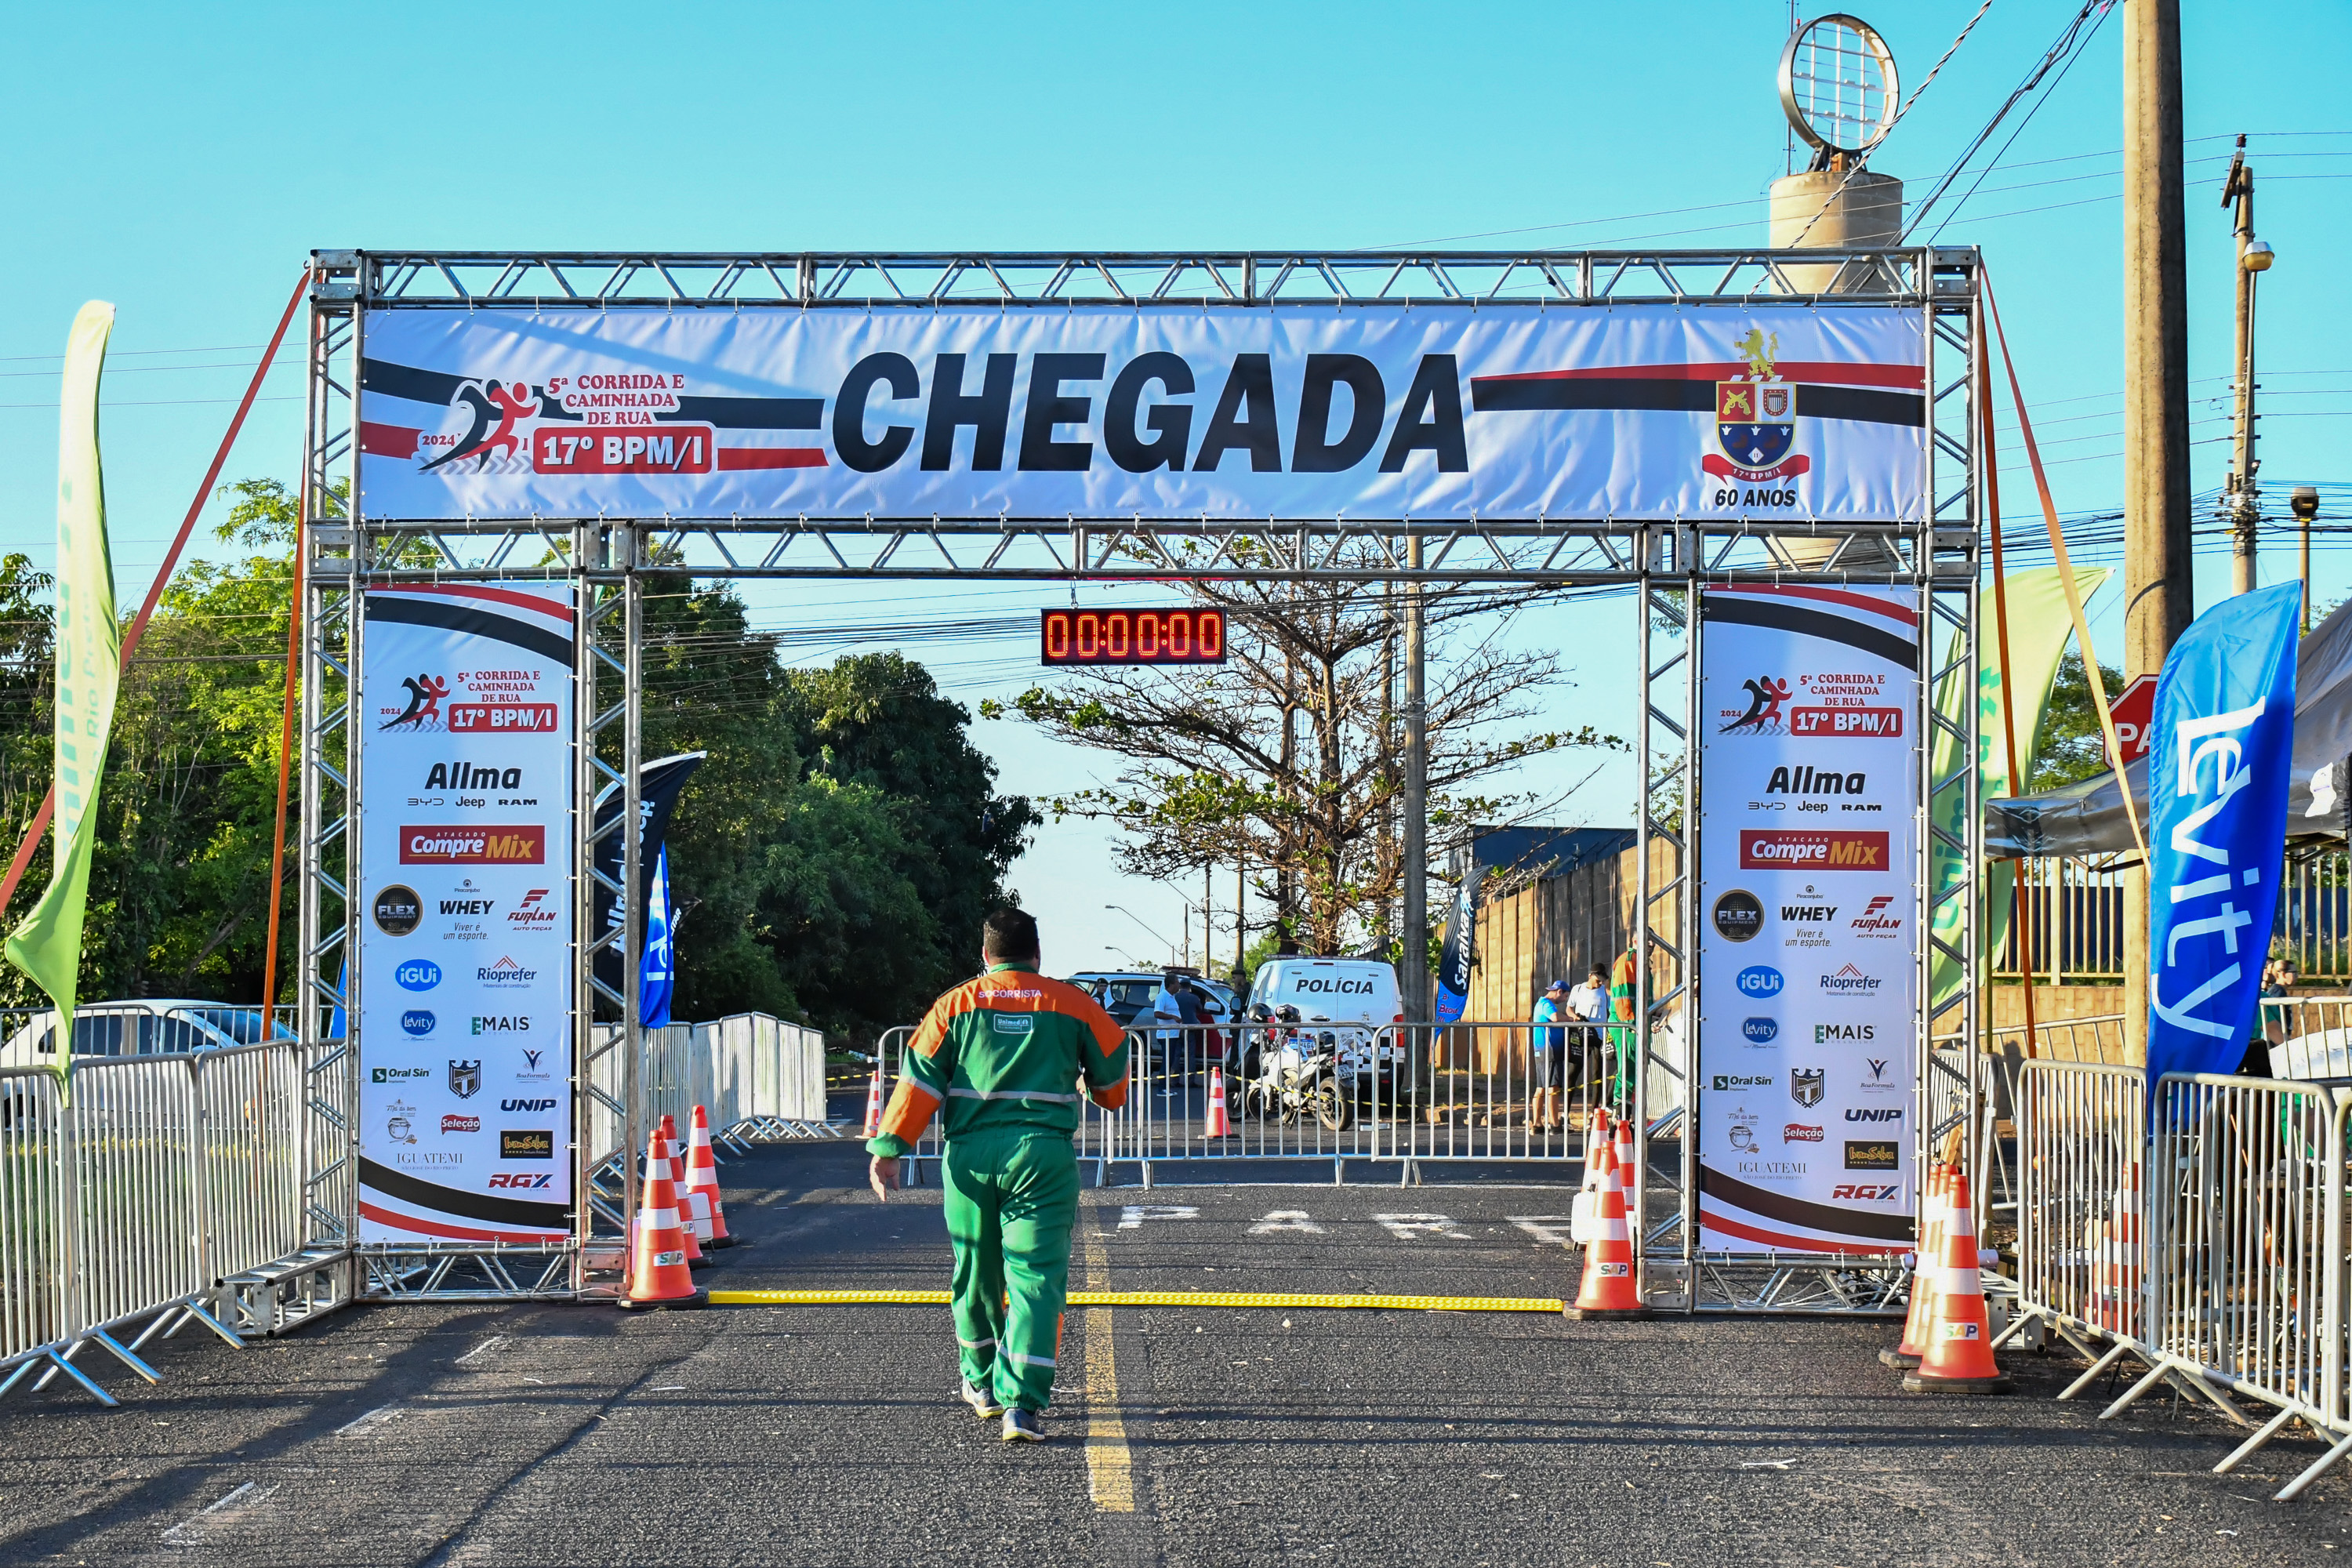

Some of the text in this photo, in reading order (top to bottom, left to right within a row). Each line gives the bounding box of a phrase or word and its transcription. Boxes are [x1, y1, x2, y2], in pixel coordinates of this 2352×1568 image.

[578, 374, 667, 390] CORRIDA
[672, 374, 684, 389] E
[564, 393, 676, 408] CAMINHADA
[587, 411, 652, 425] DE RUA
[833, 350, 1469, 474] CHEGADA
[422, 434, 456, 446] 2024
[603, 436, 702, 471] BPM/I
[1715, 488, 1797, 507] 60 ANOS
[475, 671, 530, 681] CORRIDA
[533, 671, 541, 680] E
[1818, 674, 1875, 684] CORRIDA
[1878, 675, 1886, 684] E
[468, 683, 535, 691] CAMINHADA
[1810, 686, 1880, 695] CAMINHADA
[481, 694, 521, 702] DE RUA
[1824, 697, 1865, 706] DE RUA
[491, 709, 552, 731] BPM/I
[1834, 713, 1897, 735] BPM/I
[2114, 723, 2151, 753] PA
[425, 761, 522, 789] Allma
[1766, 765, 1866, 795] Allma
[456, 796, 485, 808] Jeep
[1798, 800, 1828, 814] Jeep
[2151, 695, 2266, 1041] Levity
[378, 905, 416, 915] FLEX
[440, 900, 495, 915] WHEY
[1781, 906, 1838, 921] WHEY
[1718, 910, 1757, 920] FLEX
[454, 922, 473, 931] Viver
[1796, 928, 1816, 938] Viver
[1454, 912, 1469, 990] Saraiva
[477, 967, 537, 982] Rioprefer
[1295, 976, 1374, 995] POLÍCIA
[1820, 975, 1882, 991] Rioprefer
[978, 989, 1042, 998] SOCORRISTA
[388, 1068, 430, 1078] Oral Sin
[1730, 1076, 1772, 1086] Oral Sin
[500, 1099, 557, 1112] UNIP
[1844, 1109, 1902, 1122] UNIP
[441, 1118, 480, 1130] Seleção
[1784, 1127, 1824, 1140] Seleção
[397, 1152, 463, 1164] IGUATEMI
[1738, 1163, 1807, 1174] IGUATEMI
[660, 1253, 684, 1264] SAP
[1600, 1264, 1628, 1276] SAP
[1945, 1325, 1977, 1338] SAP
